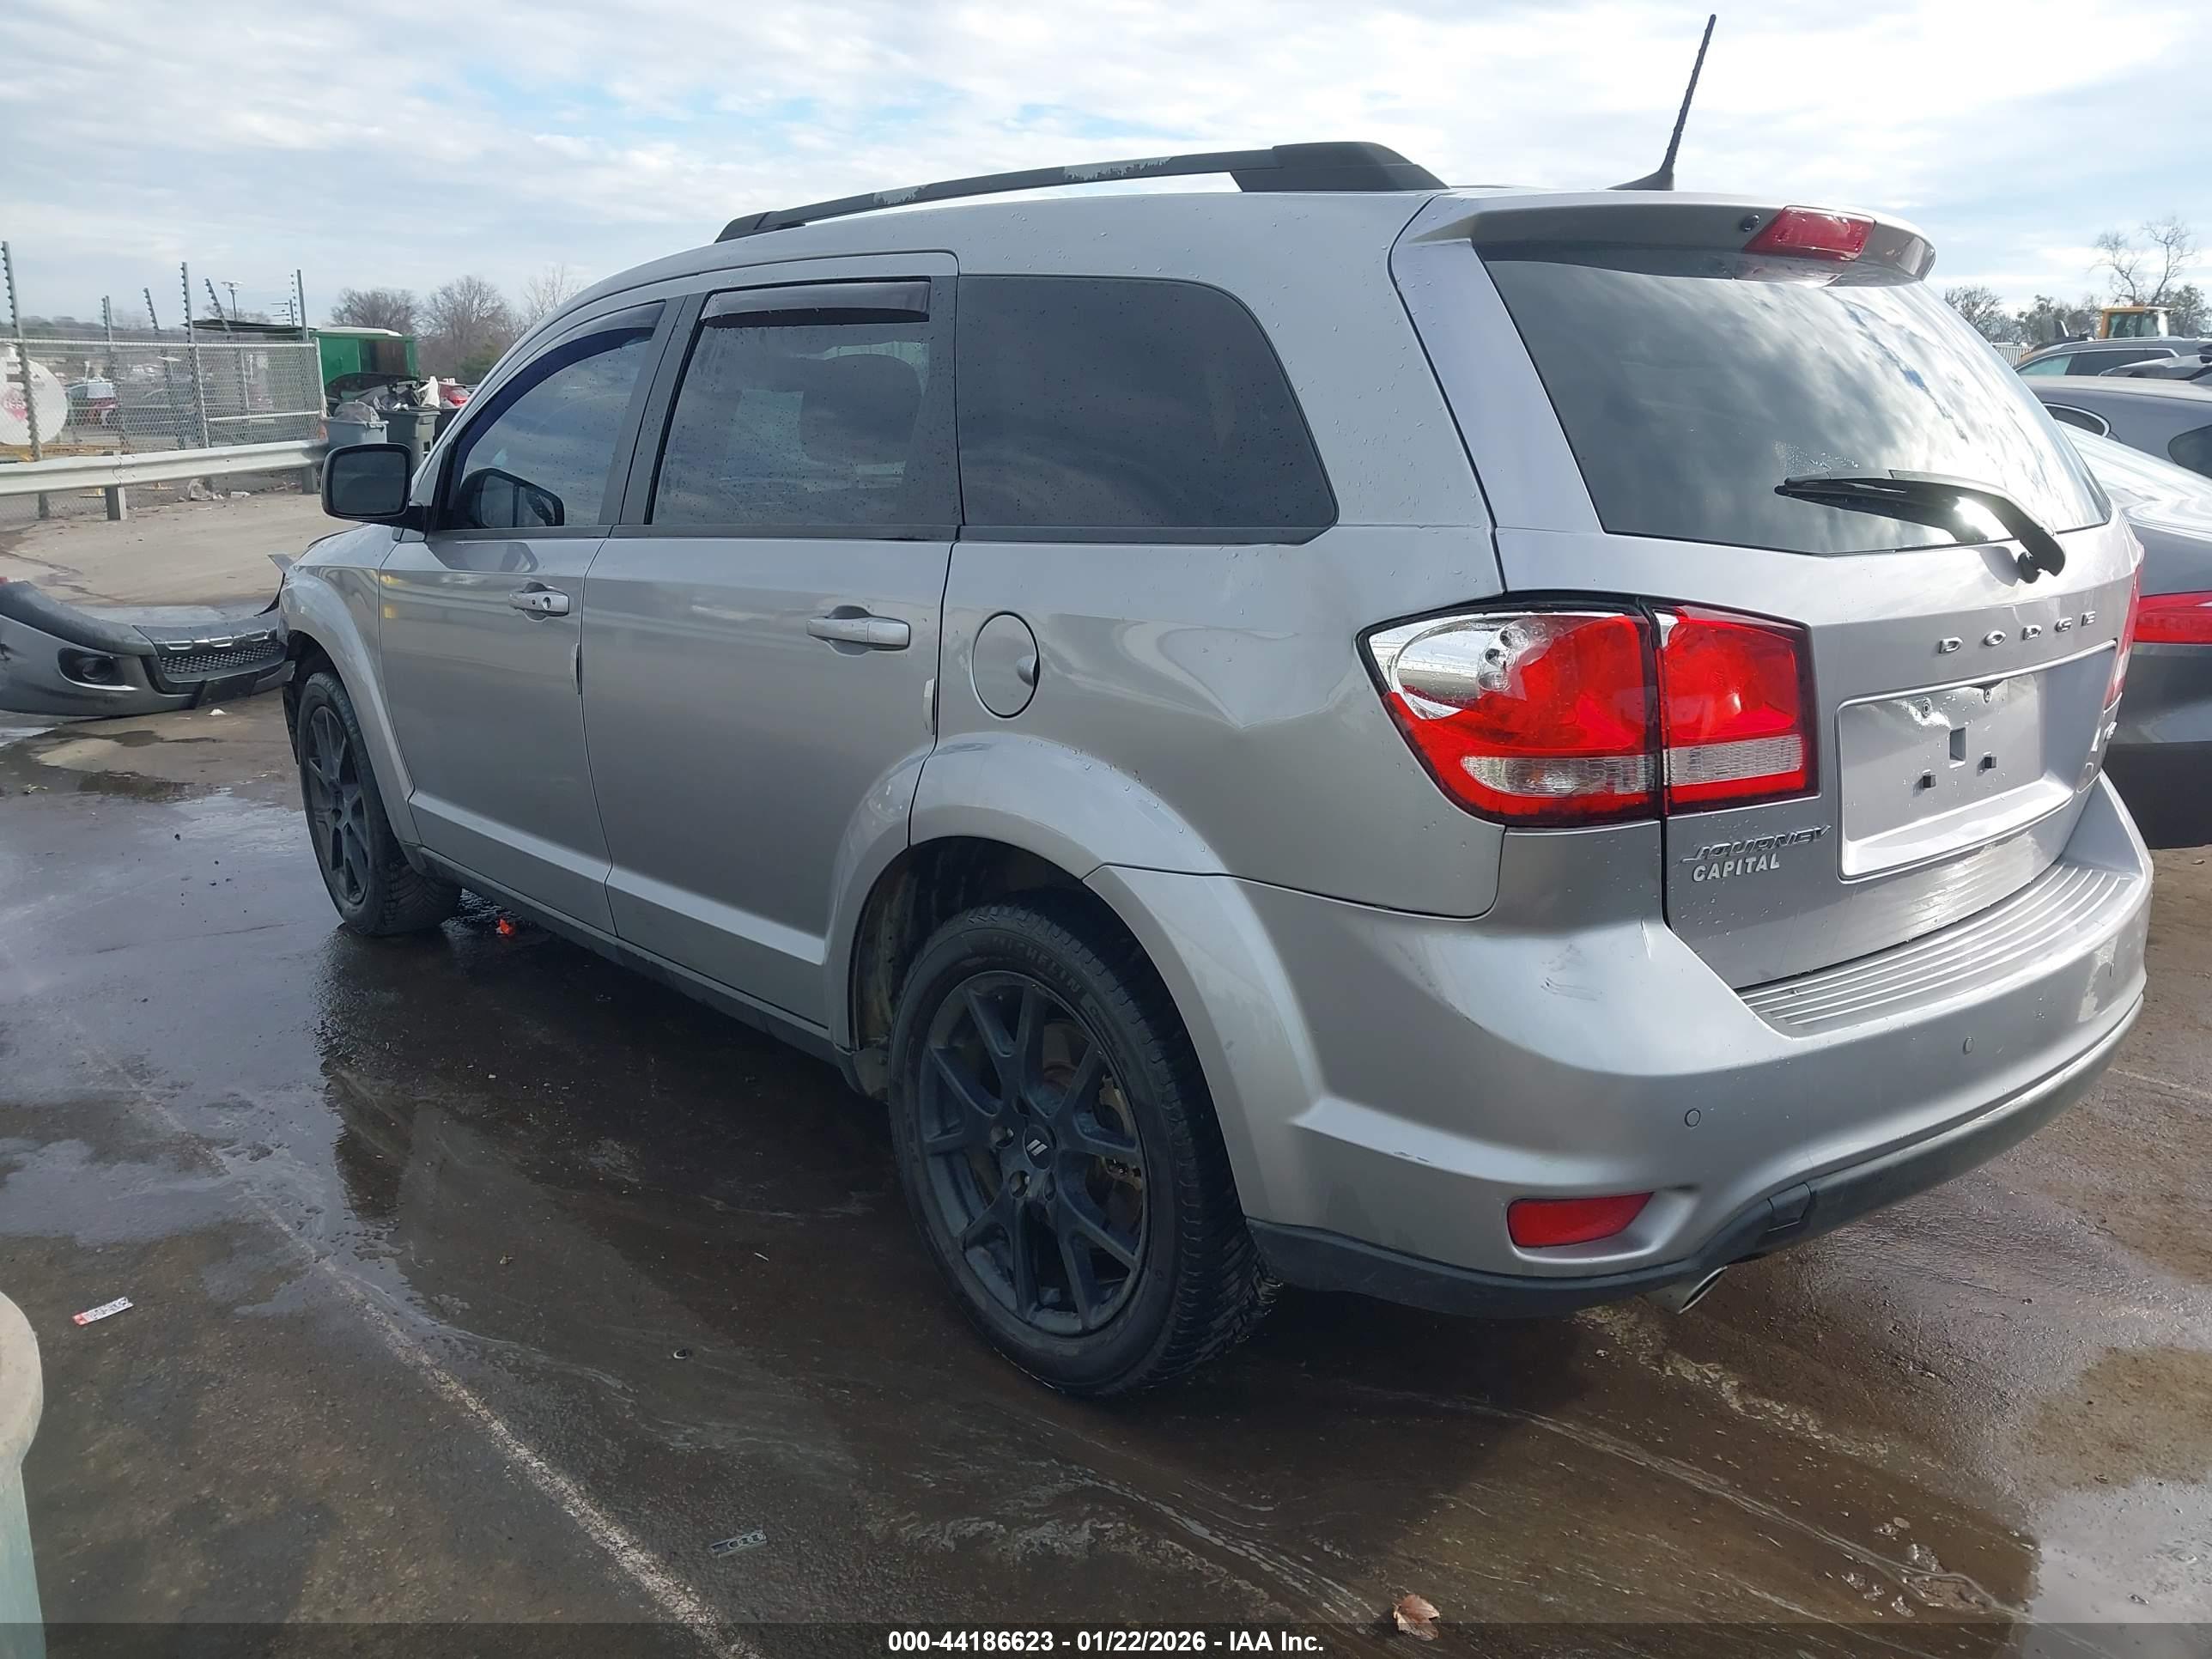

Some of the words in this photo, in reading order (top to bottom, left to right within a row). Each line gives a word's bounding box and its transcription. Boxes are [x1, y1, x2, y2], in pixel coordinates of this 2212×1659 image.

[1939, 611, 2096, 653] DODGE
[1681, 824, 1832, 862] JOURNEY
[1692, 853, 1780, 882] CAPITAL
